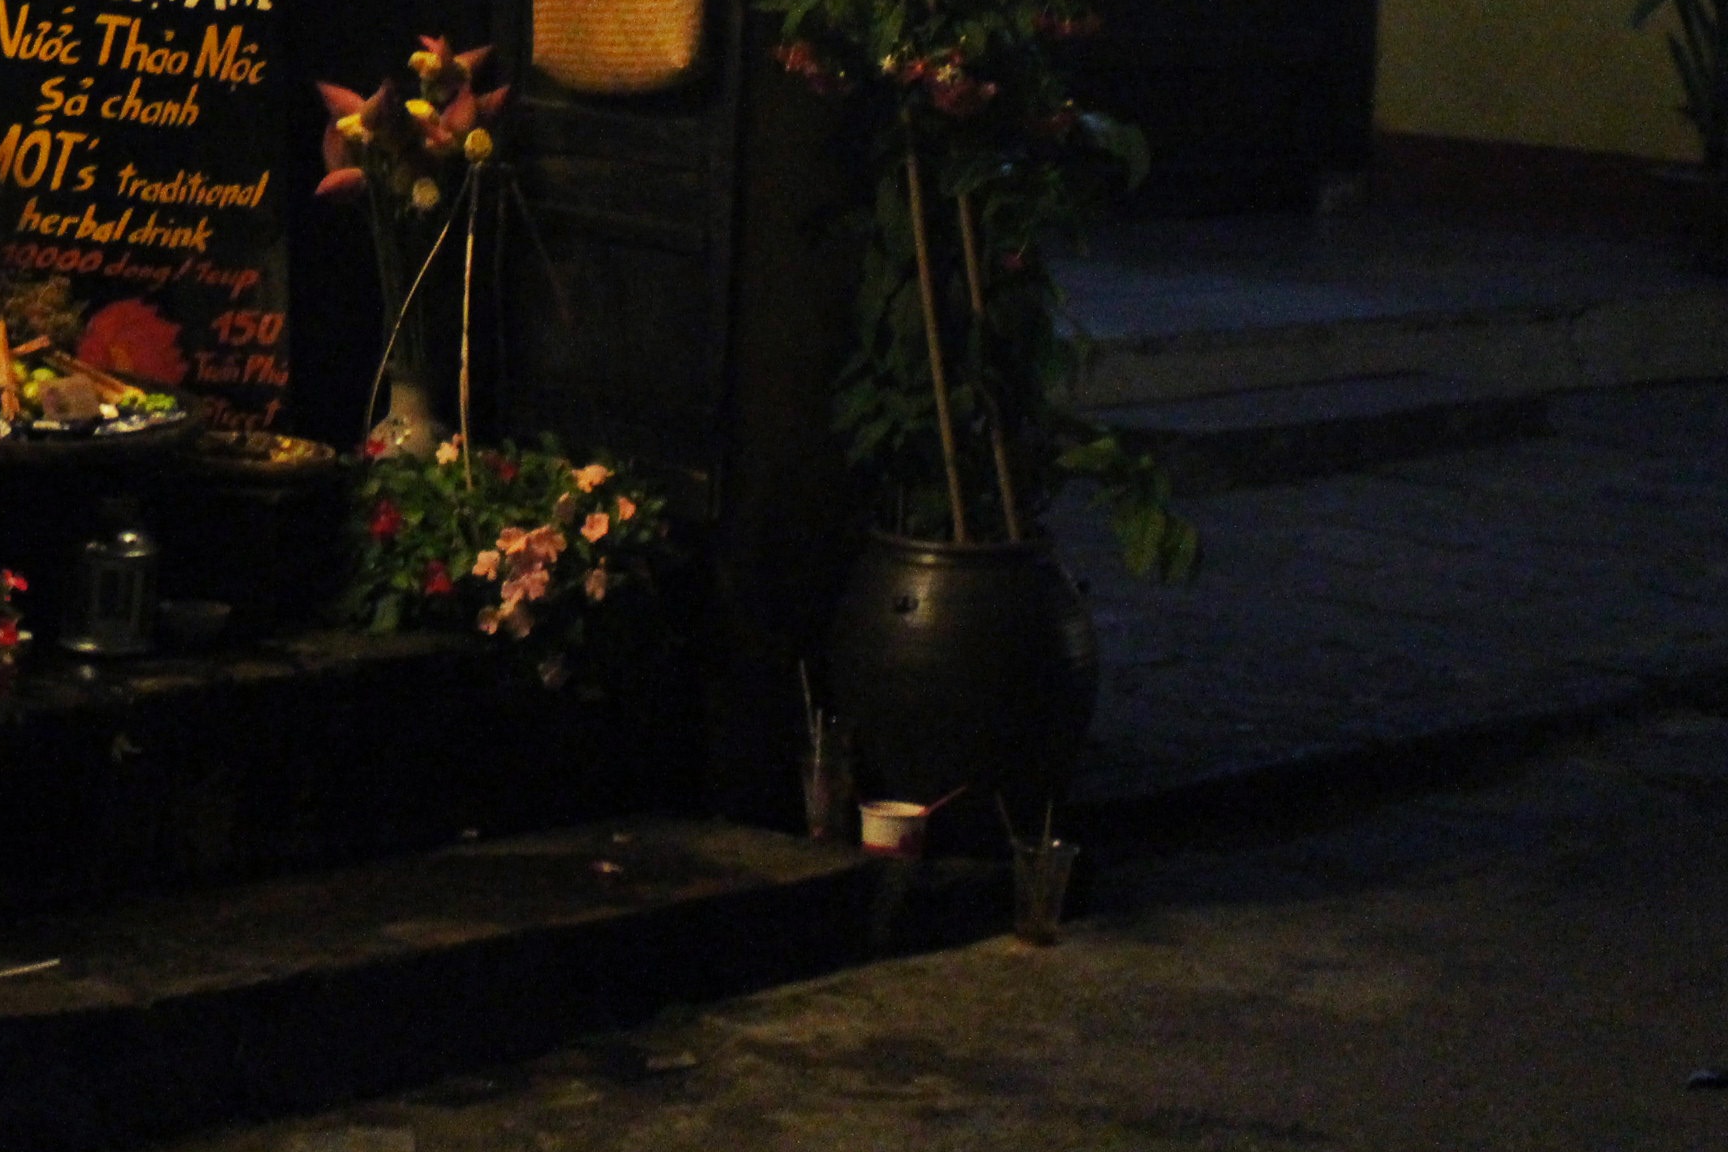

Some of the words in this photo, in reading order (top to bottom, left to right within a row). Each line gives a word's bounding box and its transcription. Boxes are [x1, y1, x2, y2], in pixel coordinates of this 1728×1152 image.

[94, 12, 190, 76] Thảo
[192, 24, 268, 92] Mộc
[100, 76, 201, 127] chanh
[117, 161, 271, 209] traditional
[18, 197, 134, 245] herbal
[127, 209, 215, 254] drink
